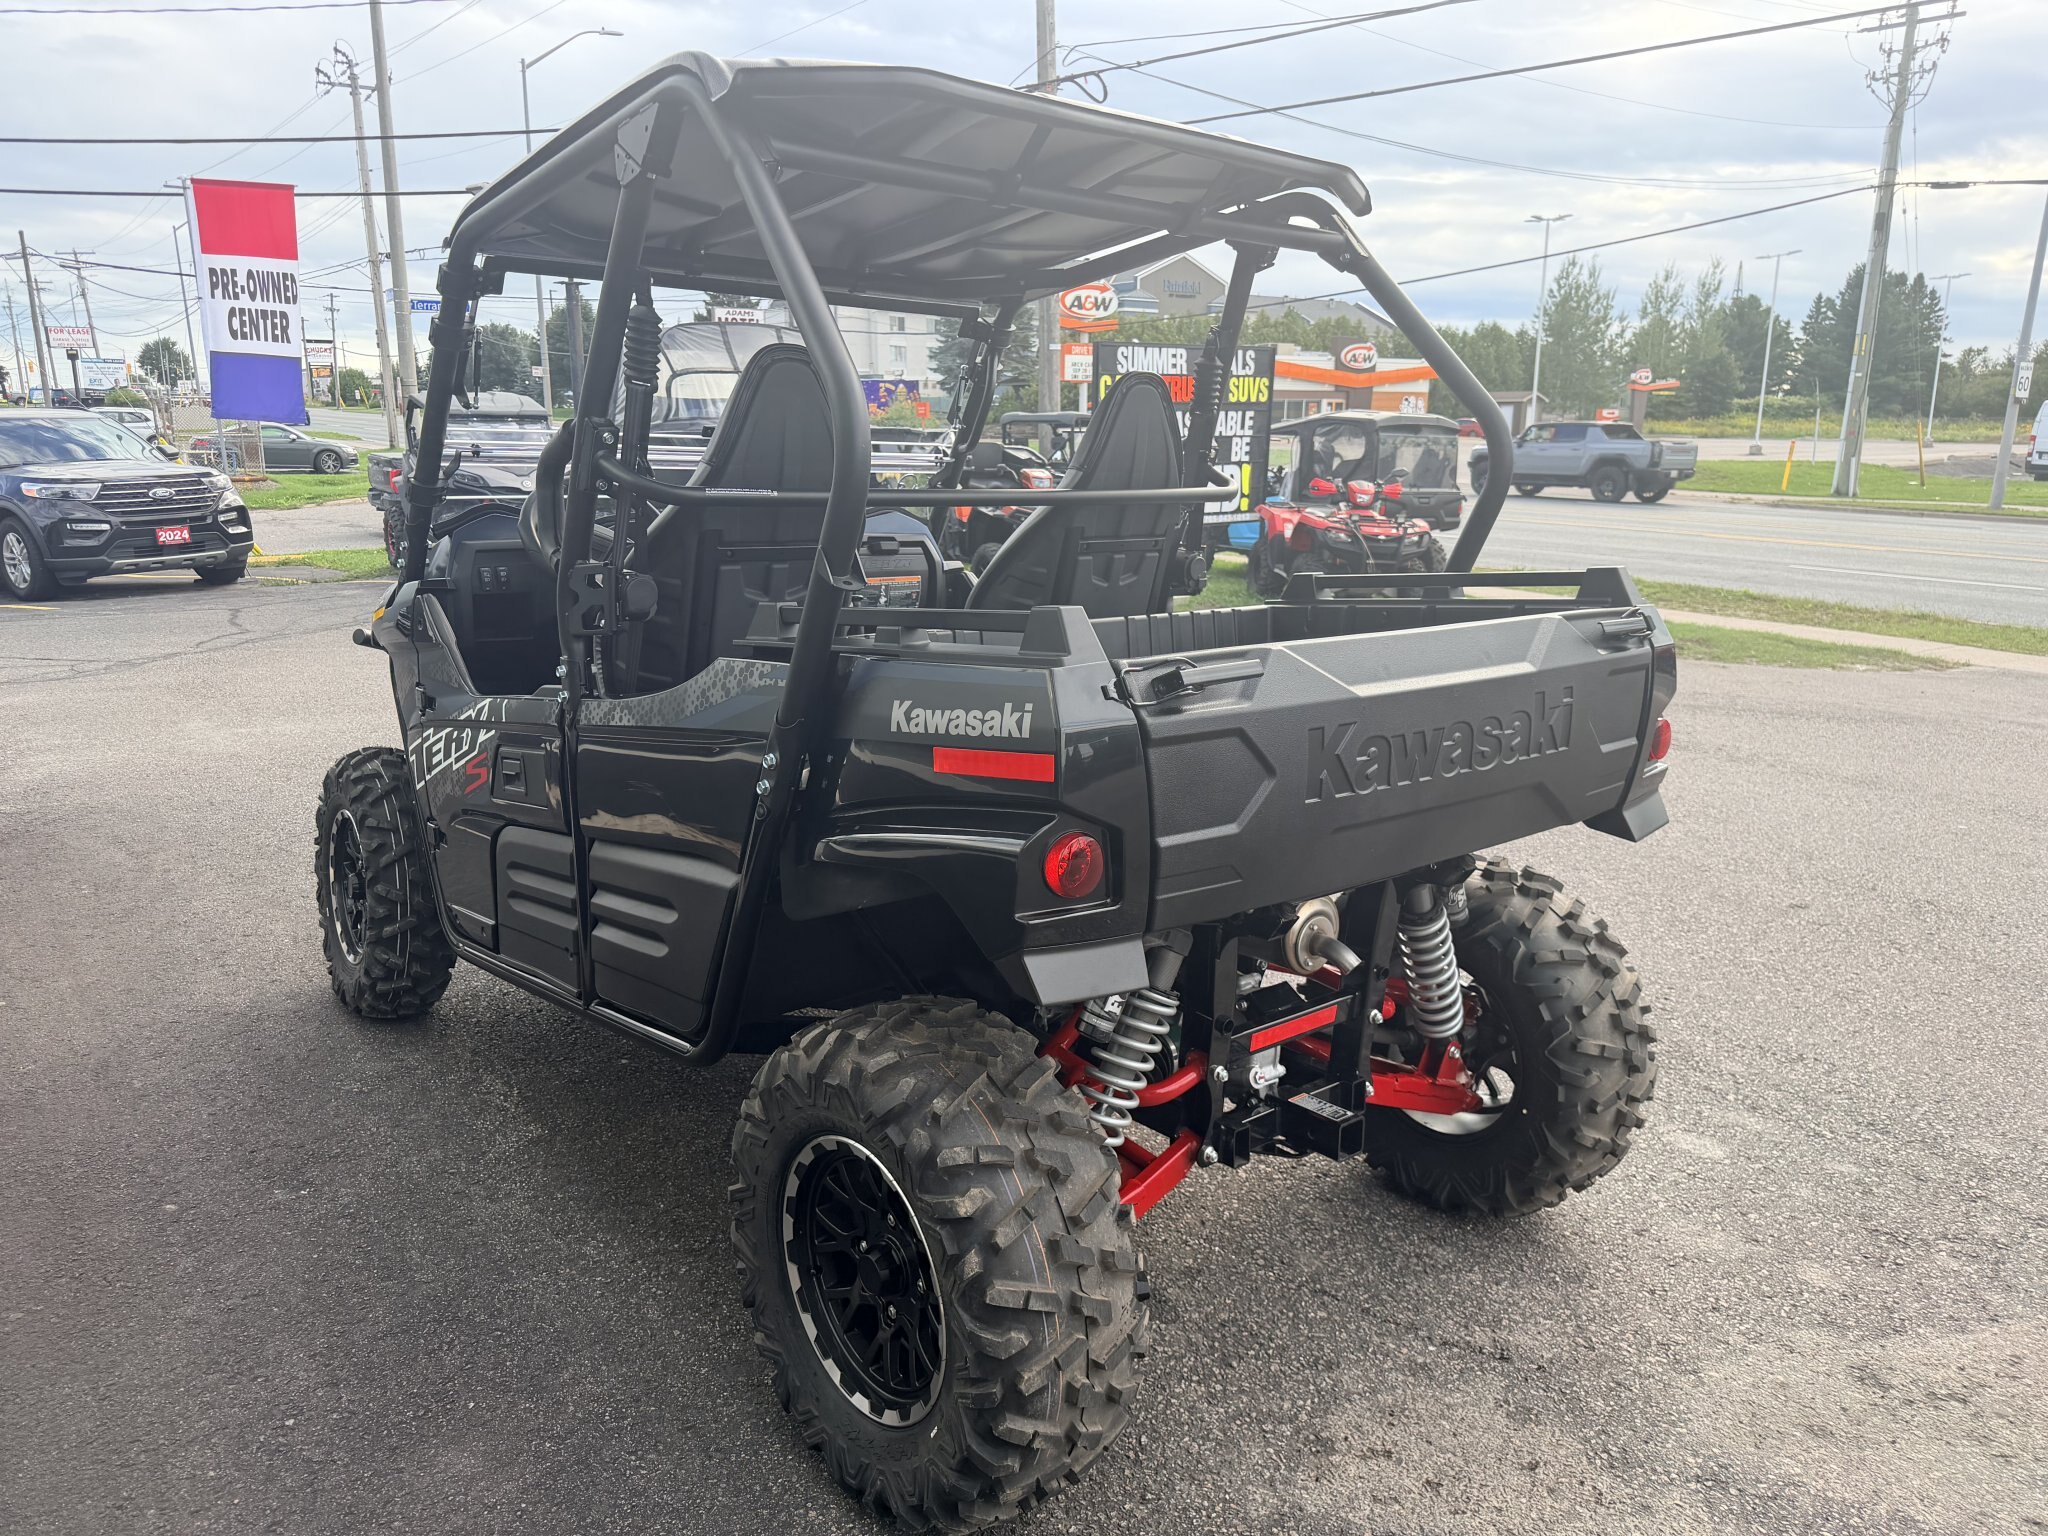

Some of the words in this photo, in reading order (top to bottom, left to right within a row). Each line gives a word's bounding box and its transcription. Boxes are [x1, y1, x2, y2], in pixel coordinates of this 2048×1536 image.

[208, 267, 298, 305] PRE-OWNED
[1069, 295, 1112, 312] A&W
[228, 306, 291, 344] CENTER
[1071, 345, 1088, 355] DRIVE
[1117, 346, 1187, 375] SUMMER
[1349, 353, 1375, 364] A&W
[1228, 376, 1269, 403] SUVS
[2017, 376, 2030, 391] 60
[1231, 437, 1251, 462] BE
[155, 489, 170, 497] Ford
[158, 529, 190, 542] 2024
[890, 700, 1034, 739] Kawasaki
[1304, 685, 1575, 804] Kawasaki
[464, 751, 488, 794] S
